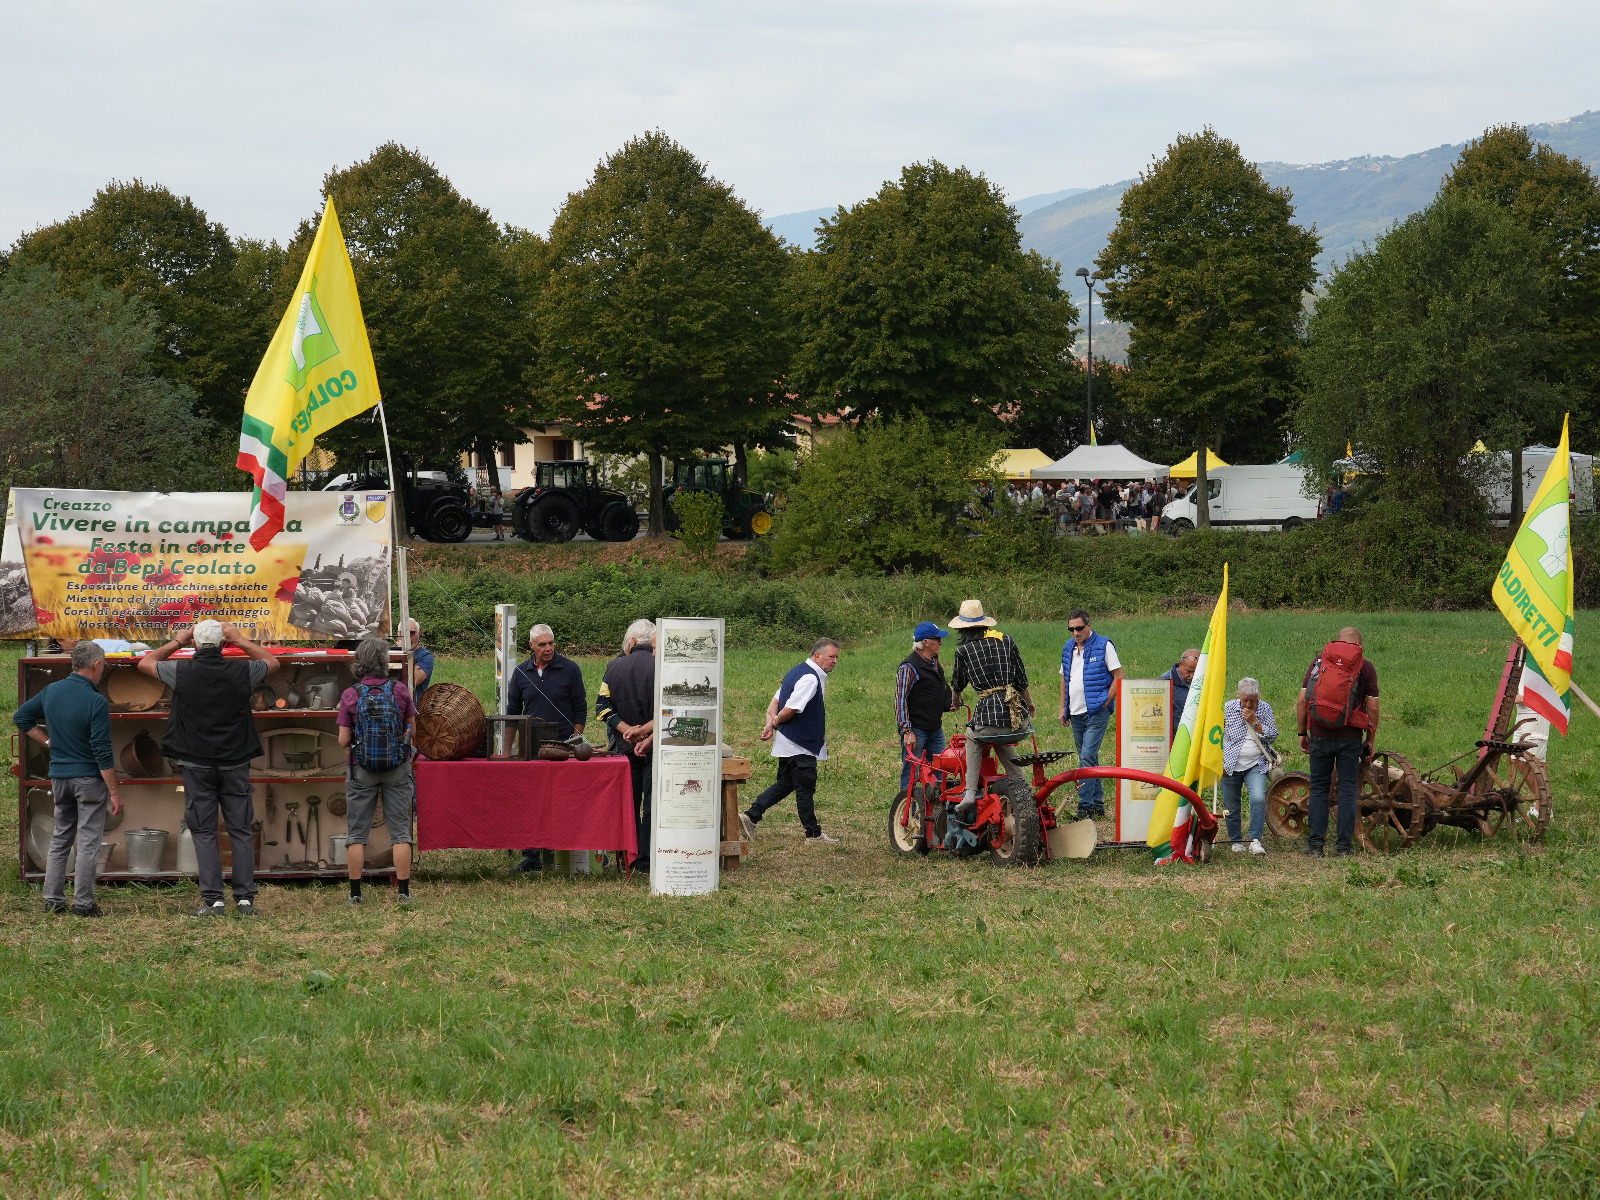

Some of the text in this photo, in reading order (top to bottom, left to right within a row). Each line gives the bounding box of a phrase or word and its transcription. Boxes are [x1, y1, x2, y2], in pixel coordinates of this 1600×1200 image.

[43, 497, 112, 512] Creazzo
[32, 512, 303, 540] Vivere in campaa
[90, 537, 246, 554] Festa in corte
[78, 558, 257, 580] da Bepi Ceolato
[66, 581, 268, 593] Esposizione di macchine storiche
[65, 594, 269, 607] Mietitura del grano e trebbiatura
[1500, 561, 1559, 648] OLDIRETTI
[64, 606, 94, 616] Corsi
[96, 607, 109, 616] di
[111, 607, 181, 619] agricoltura
[192, 607, 271, 619] giardinaggio
[78, 620, 121, 629] Mostre
[123, 621, 132, 629] e
[135, 619, 170, 629] stand
